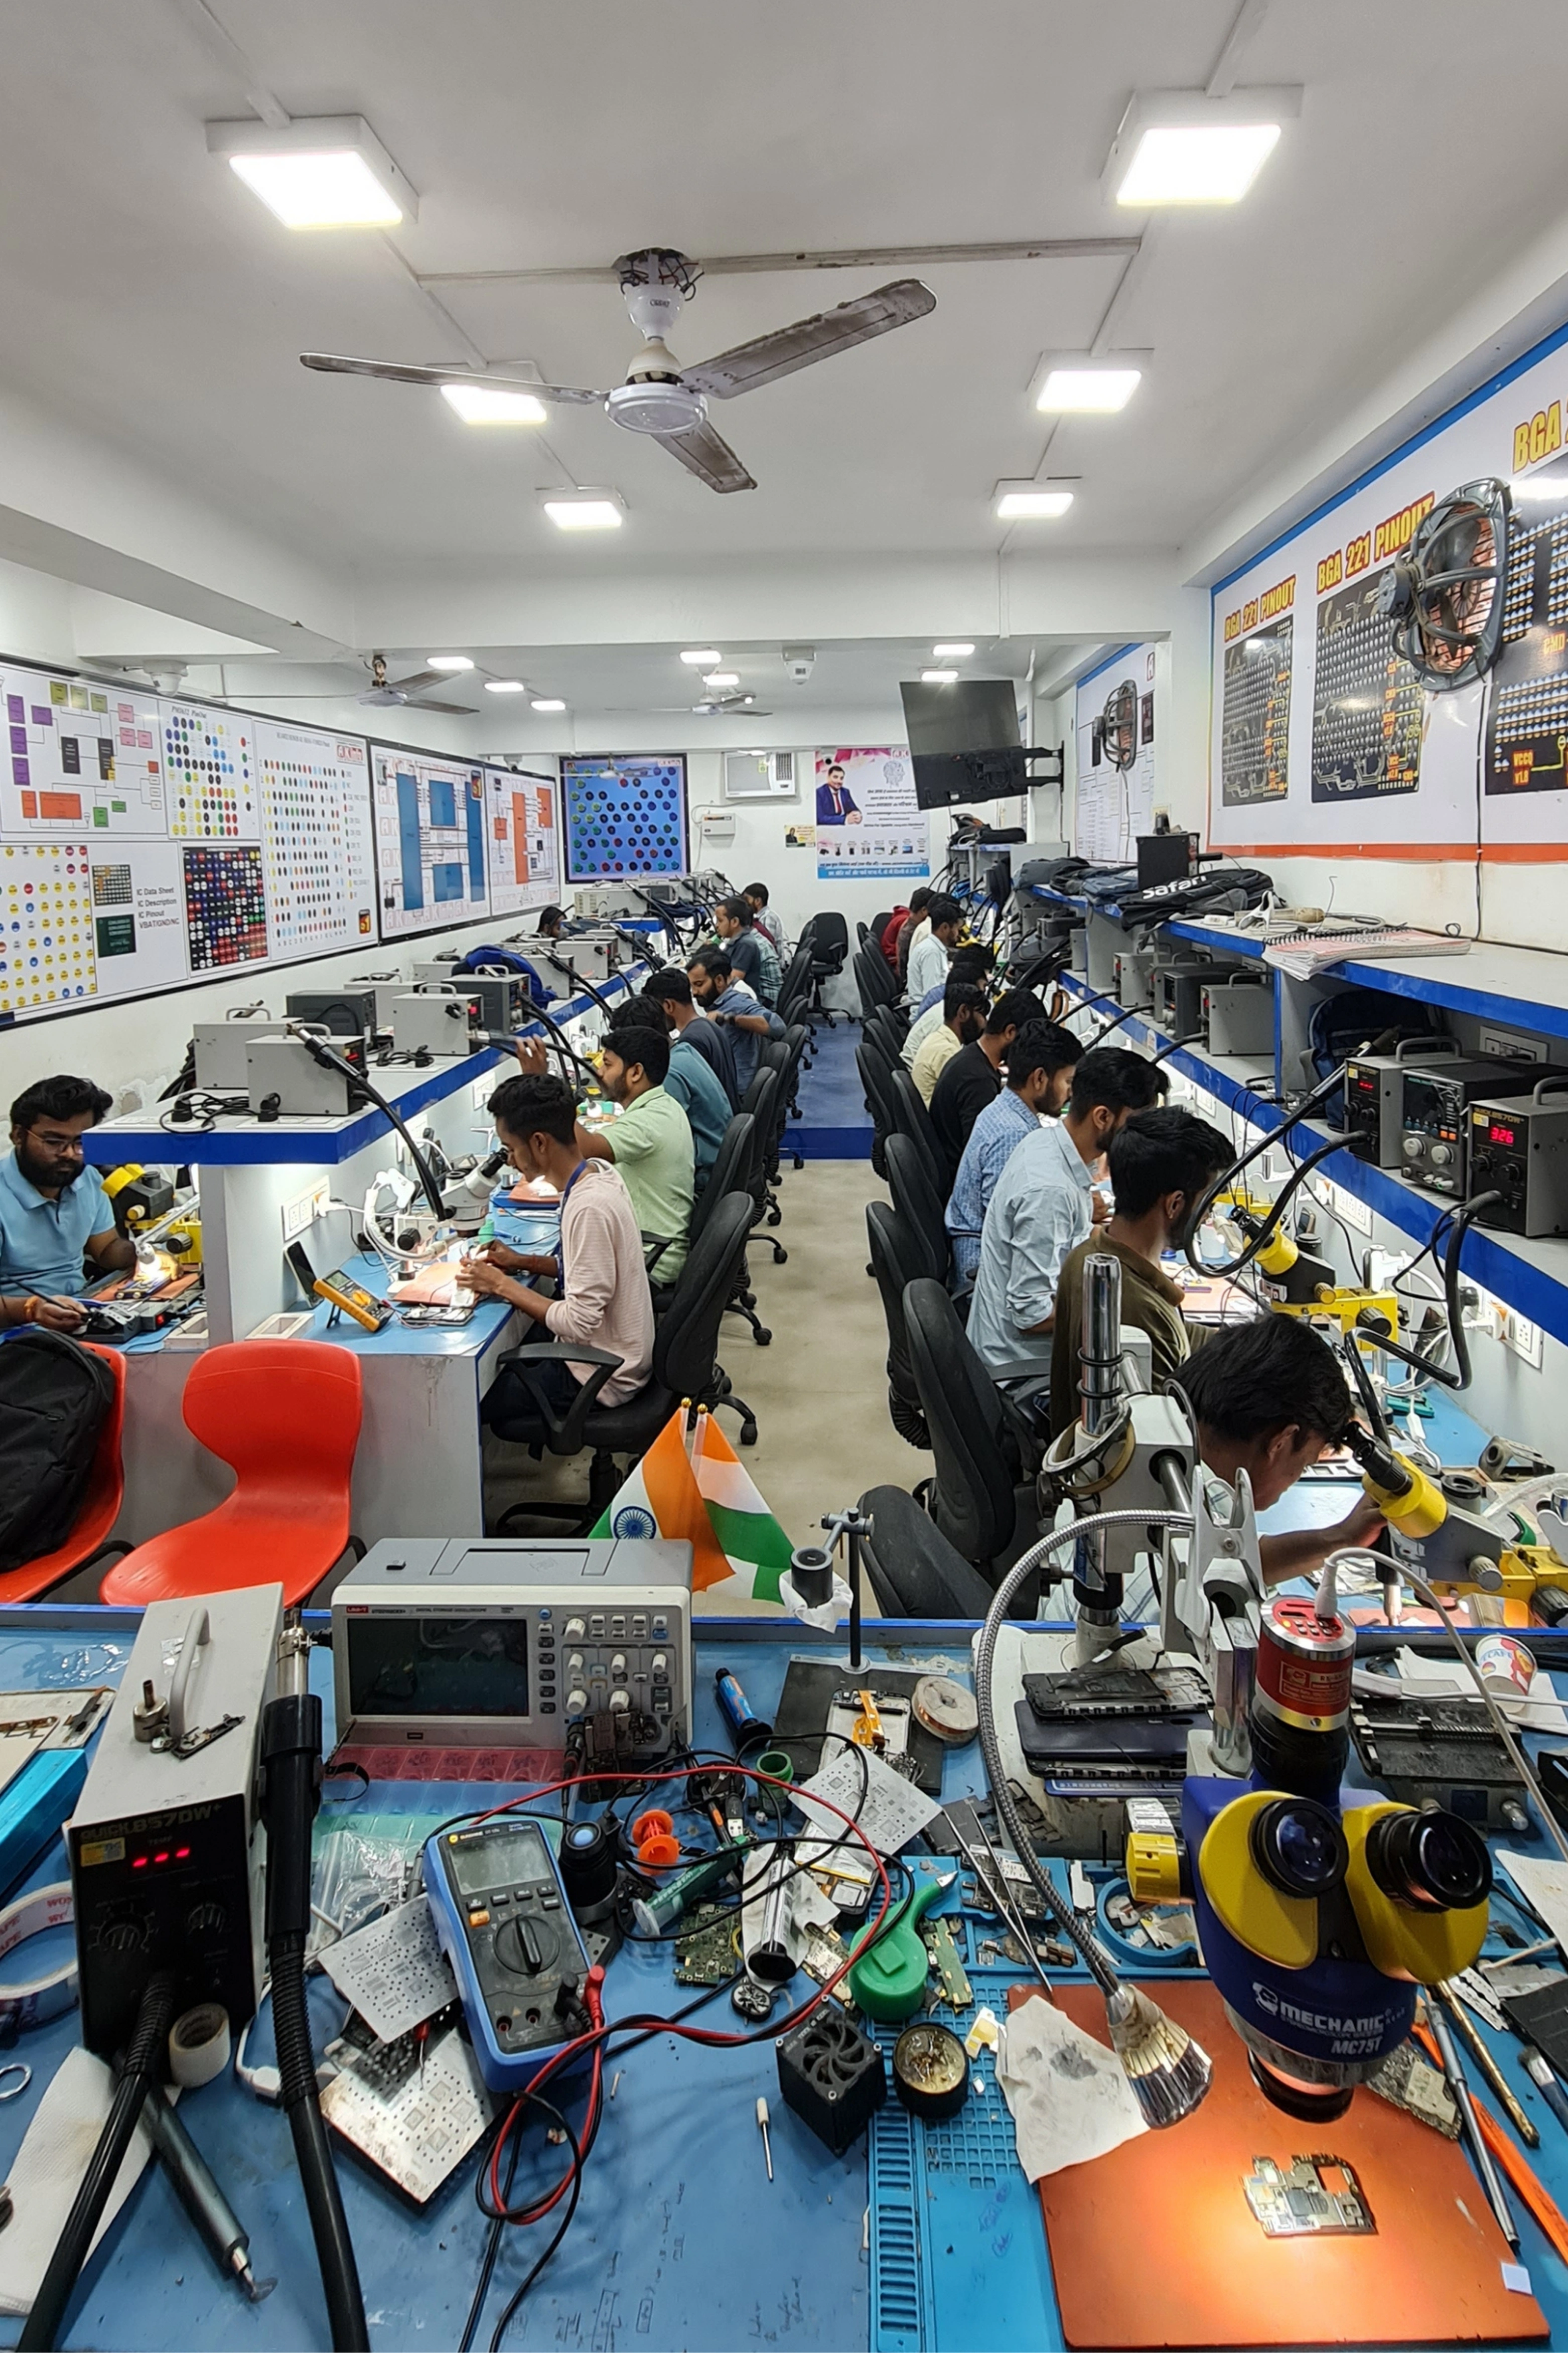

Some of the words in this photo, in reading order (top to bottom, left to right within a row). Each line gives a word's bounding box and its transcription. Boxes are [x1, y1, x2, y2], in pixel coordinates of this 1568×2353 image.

[1513, 400, 1562, 474] BGA
[1317, 549, 1342, 595] BGA
[1345, 530, 1371, 578] 221
[1374, 490, 1435, 563] PINOUT
[1224, 610, 1240, 642] BGA
[1242, 597, 1258, 633] 221
[1260, 575, 1296, 622] PINOUT
[1543, 631, 1565, 655] CMD
[1512, 749, 1533, 767] VCCQ
[144, 898, 177, 907] Description
[146, 910, 165, 918] Pinout
[1491, 1127, 1514, 1144] 326
[1280, 2001, 1384, 2033] MECHANIC
[1331, 2035, 1383, 2055] MC75T
